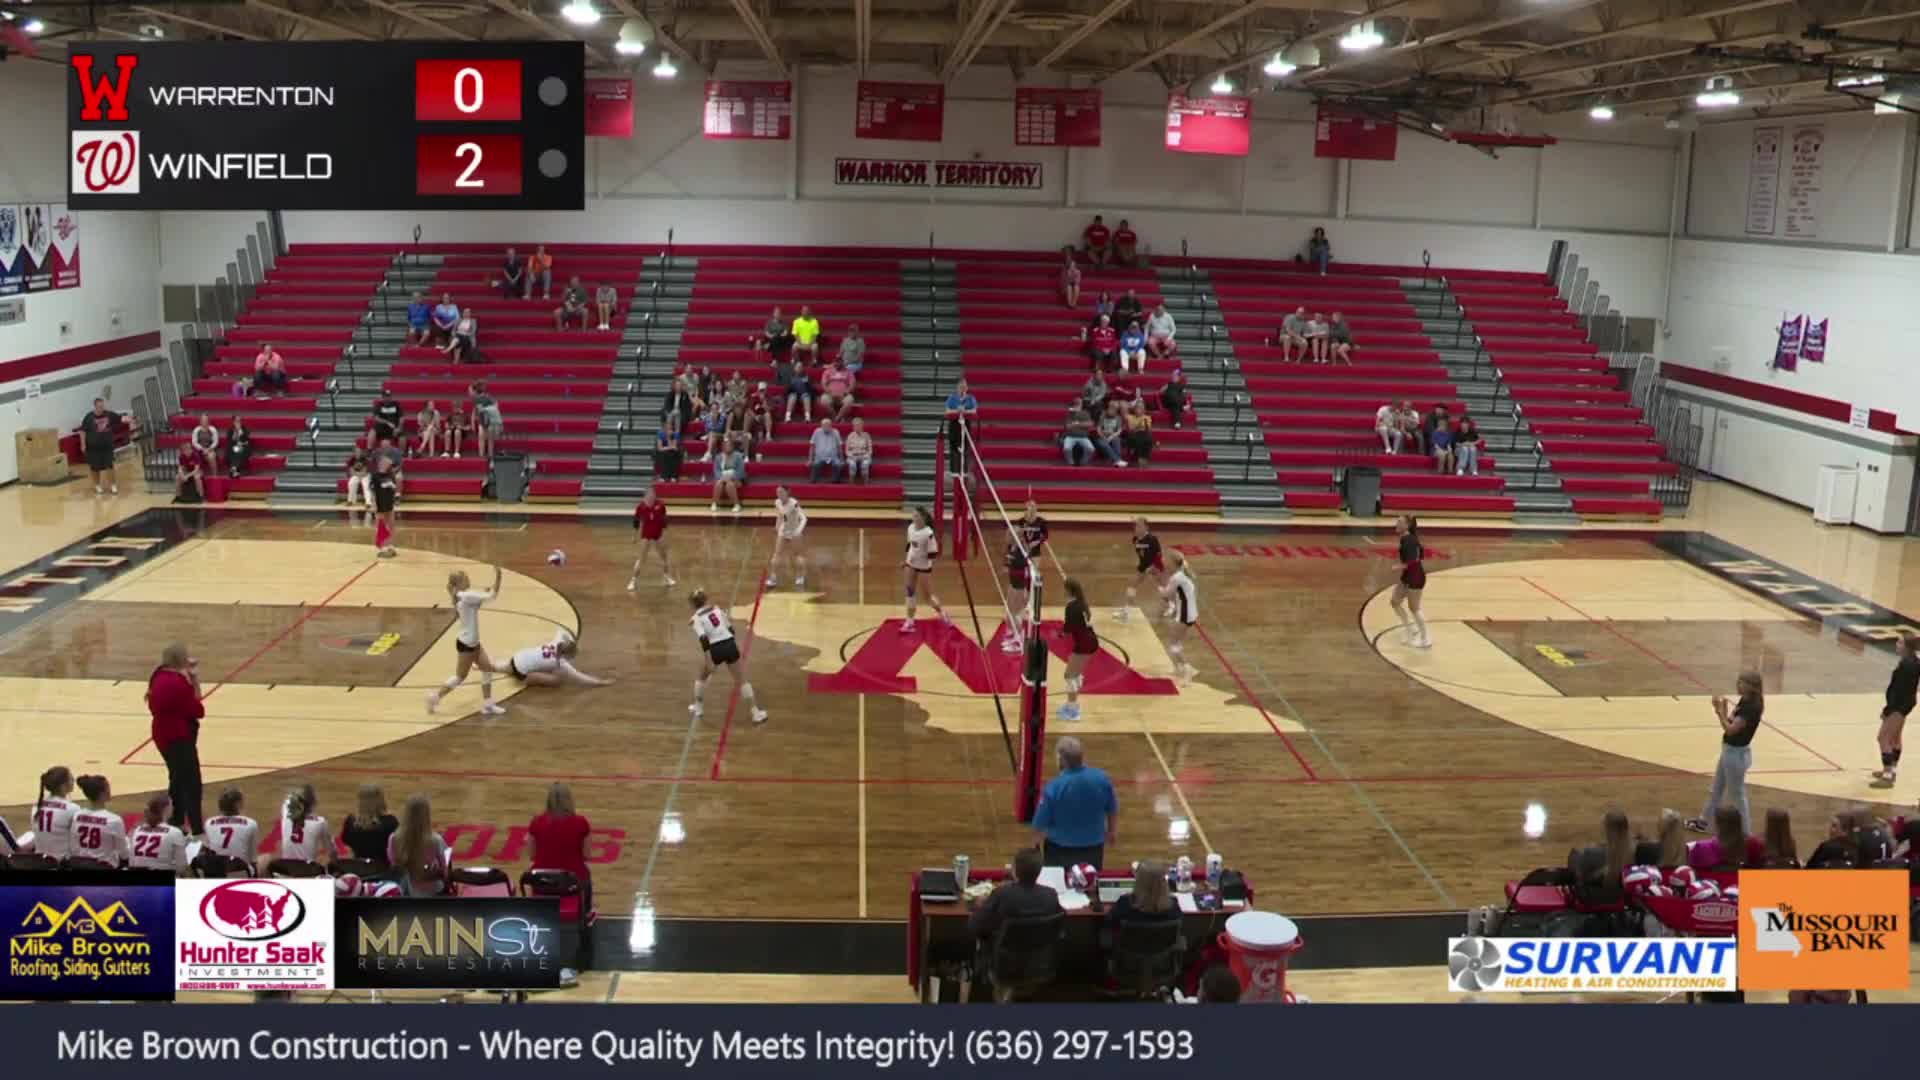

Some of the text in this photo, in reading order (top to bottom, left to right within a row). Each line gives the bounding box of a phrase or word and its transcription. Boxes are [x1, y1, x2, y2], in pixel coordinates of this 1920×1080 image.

[838, 161, 1040, 186] WARRIOR TERRITORY
[37, 809, 54, 833] 11
[134, 834, 162, 859] 22
[220, 827, 234, 849] 7
